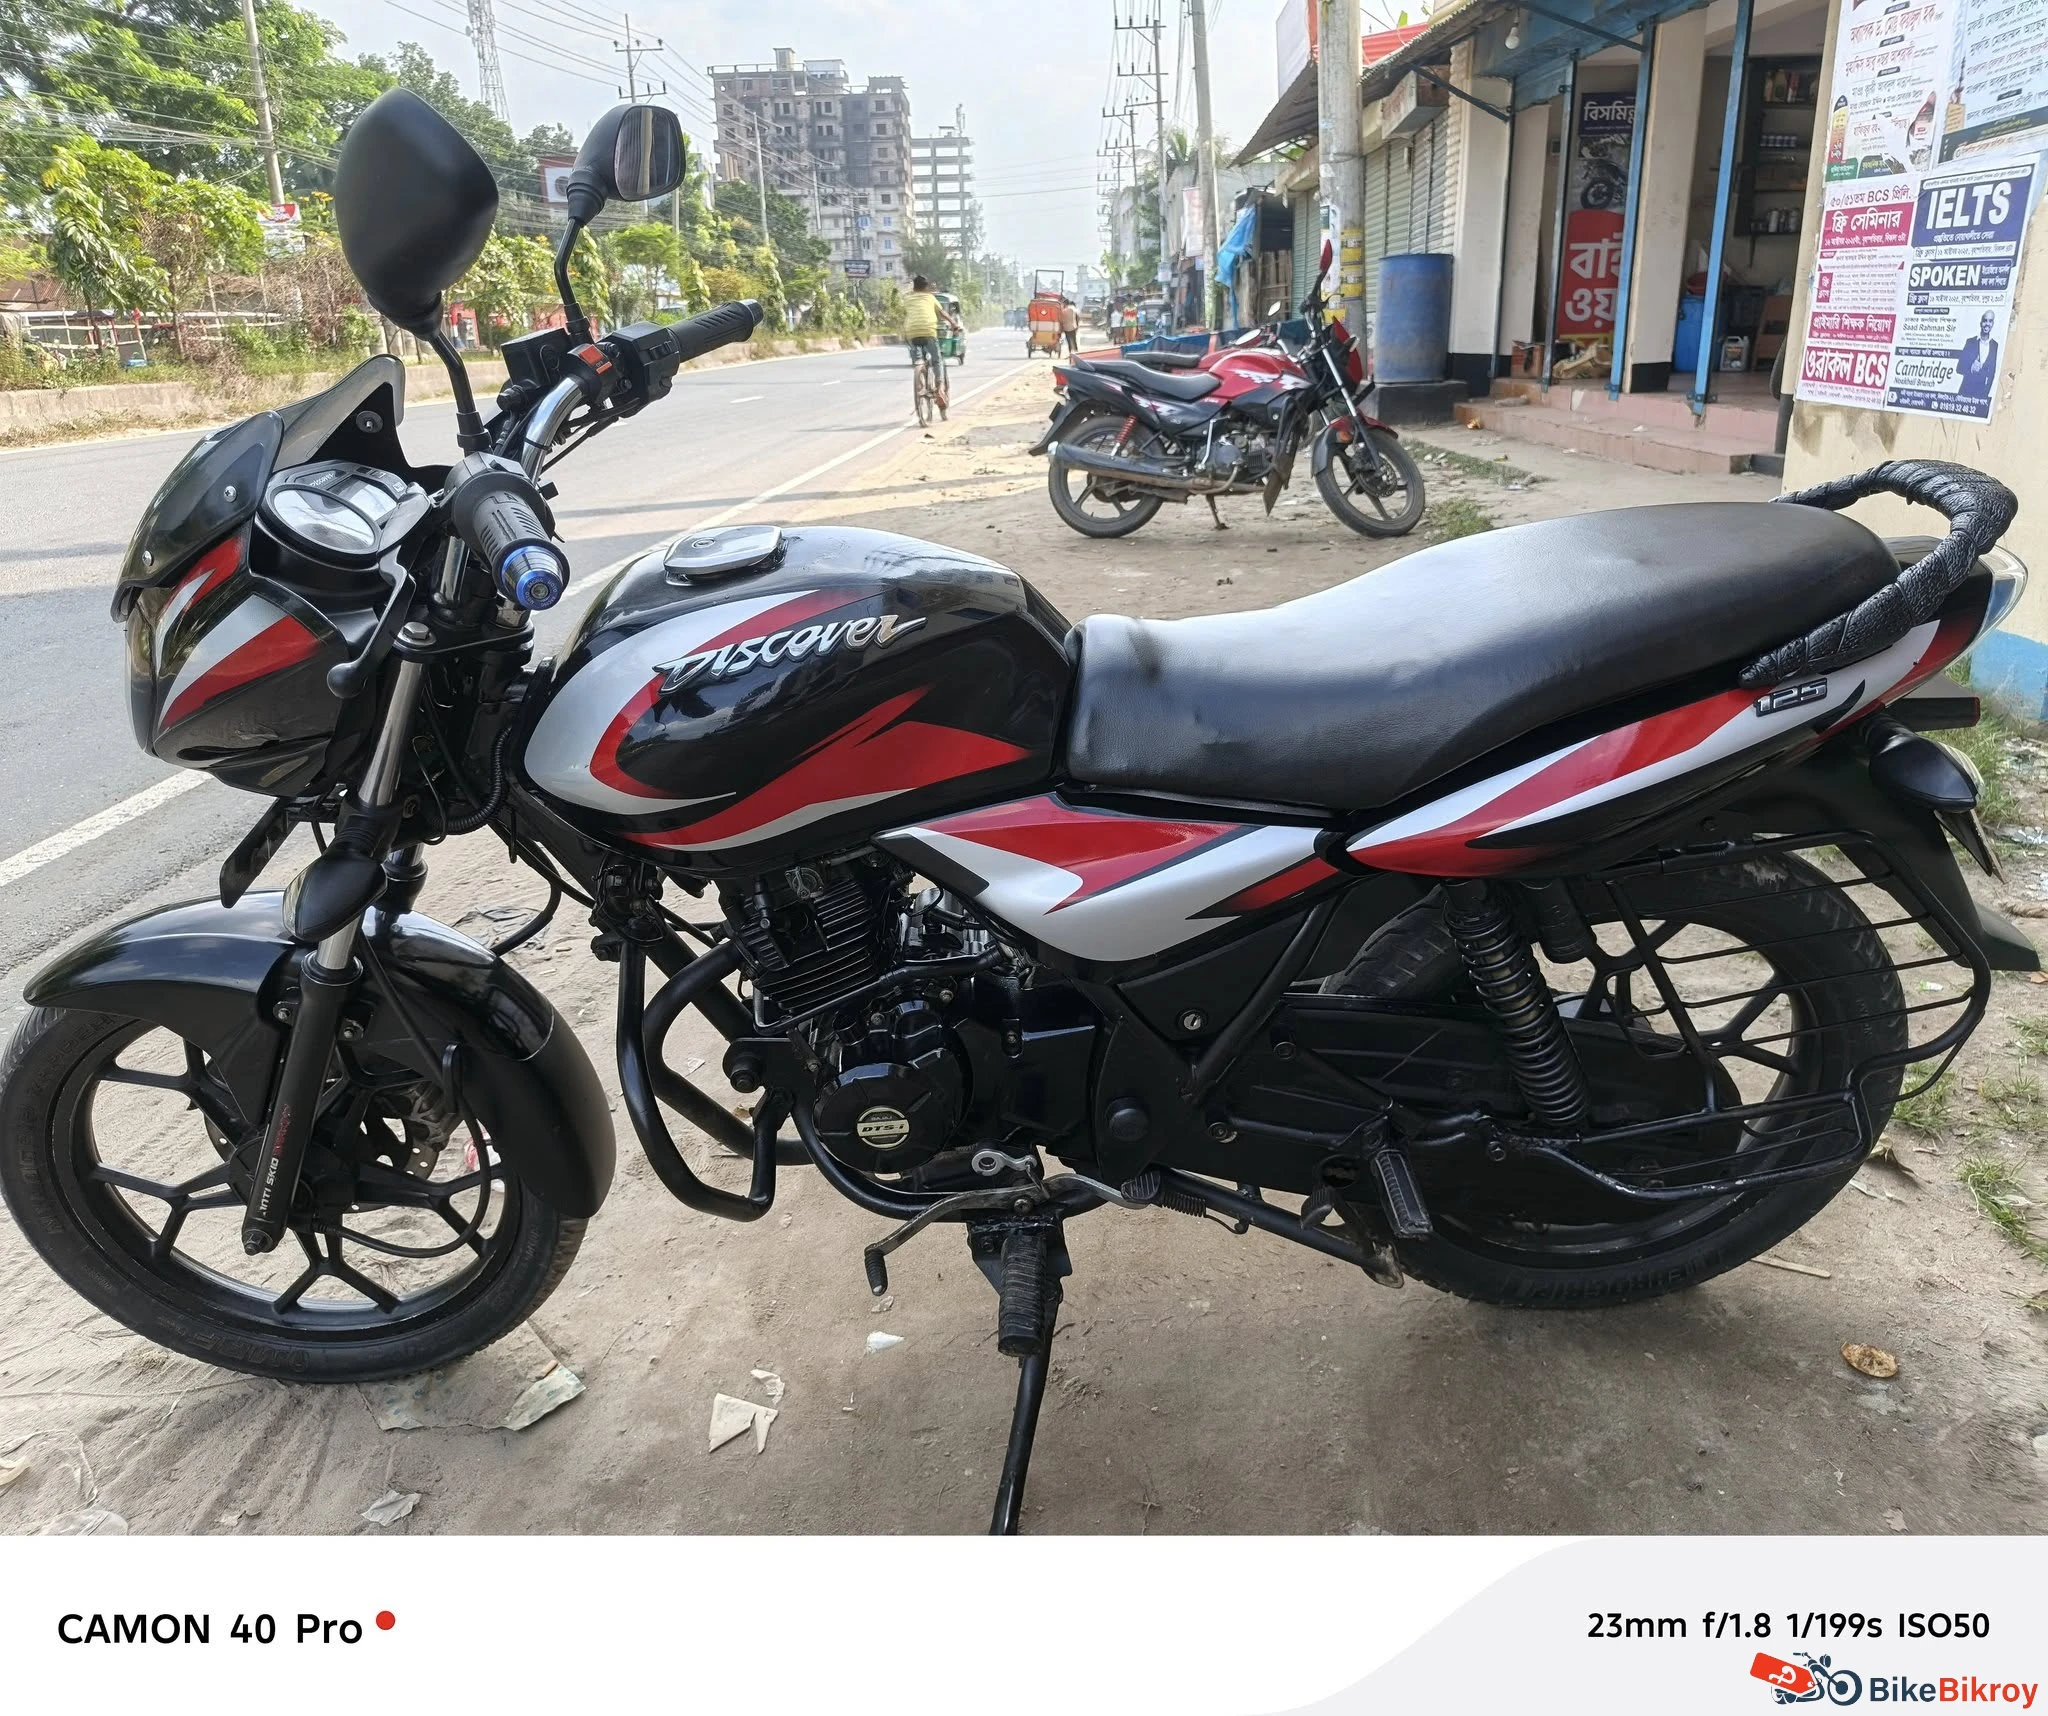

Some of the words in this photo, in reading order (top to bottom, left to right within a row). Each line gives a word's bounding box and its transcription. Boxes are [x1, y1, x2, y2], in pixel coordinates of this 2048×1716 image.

[1867, 188, 1890, 203] BCS
[1926, 181, 2012, 230] IELTS
[1832, 210, 1849, 235] ফ্রি
[1851, 207, 1903, 231] সেমিনার
[1909, 264, 1981, 288] SPOKEN
[1840, 314, 1865, 331] শিক্ষক
[1866, 314, 1892, 332] নিয়োগ
[1903, 323, 1918, 331] Saad
[1919, 323, 1945, 332] Rahman
[1946, 324, 1956, 333] Sir
[1805, 348, 1855, 382] ওরাকল
[1853, 352, 1888, 387] BCS
[1895, 359, 1954, 384] Cambridge
[1916, 378, 1935, 388] Branch
[1755, 679, 1827, 714] 125
[266, 1157, 279, 1186] SKID
